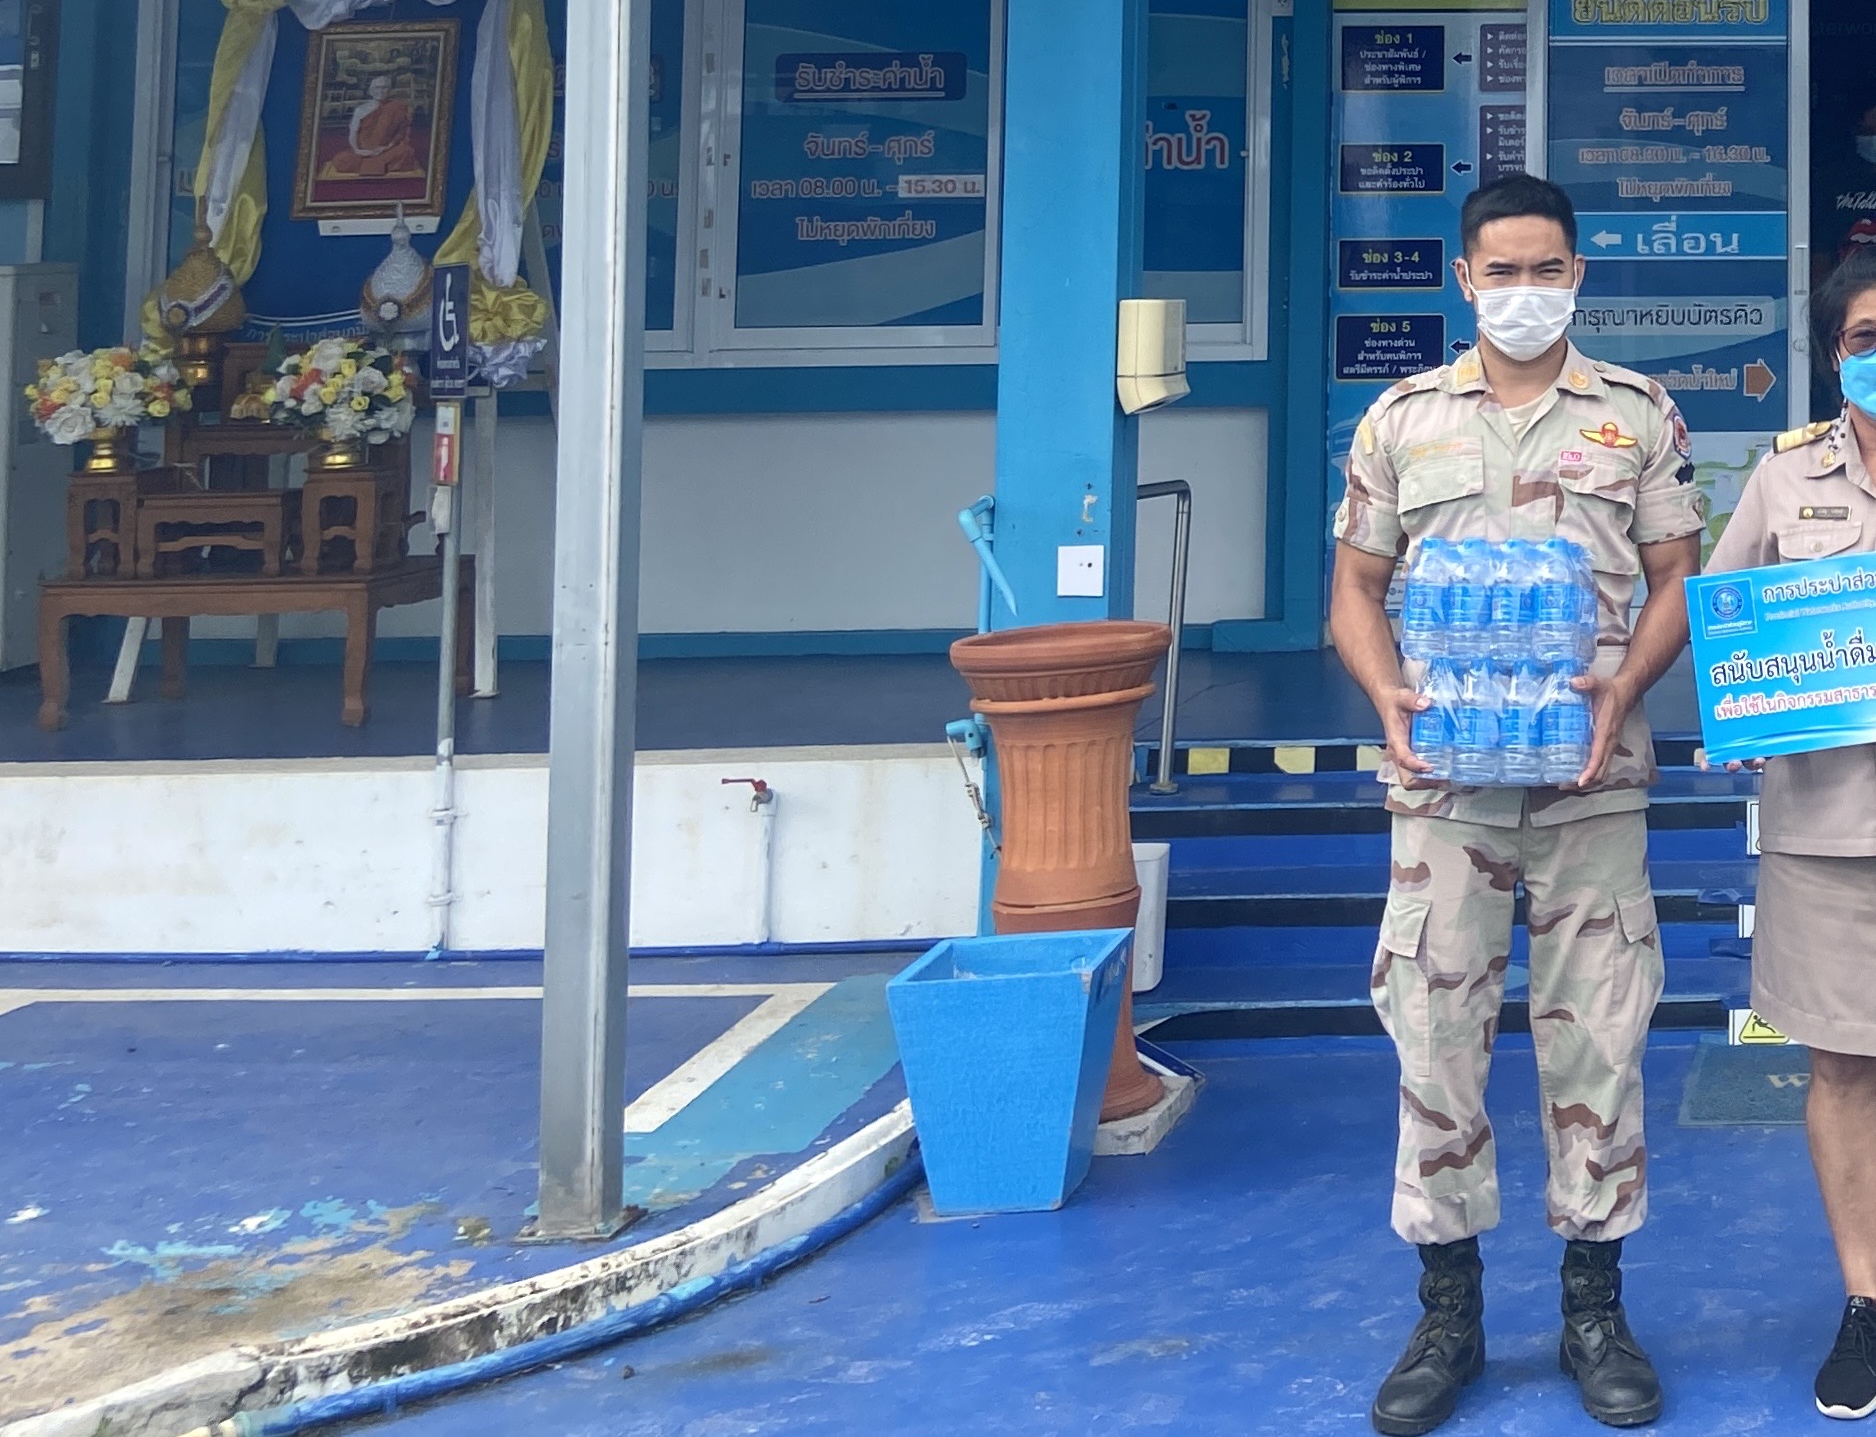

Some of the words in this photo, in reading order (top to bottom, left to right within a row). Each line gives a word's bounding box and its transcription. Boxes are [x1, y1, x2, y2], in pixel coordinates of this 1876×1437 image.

[1375, 33, 1400, 45] ช่อง
[1406, 34, 1412, 44] 1
[795, 56, 945, 90] รับชำระค่าน้ำ
[1372, 150, 1398, 162] ช่อง
[1404, 151, 1412, 162] 2
[752, 180, 796, 198] เวลา
[799, 178, 858, 197] 08.00
[904, 179, 957, 194] 15.30
[797, 211, 936, 242] ไม่หยุดพักเที่ยง
[1637, 215, 1739, 254] เลื่อน
[1363, 250, 1388, 263] ช่อง
[1394, 251, 1420, 262] 3-4
[1371, 319, 1396, 333] ช่อง
[1402, 321, 1411, 332] 5
[1571, 304, 1763, 333] กรุณาหยิบบัตรคิว
